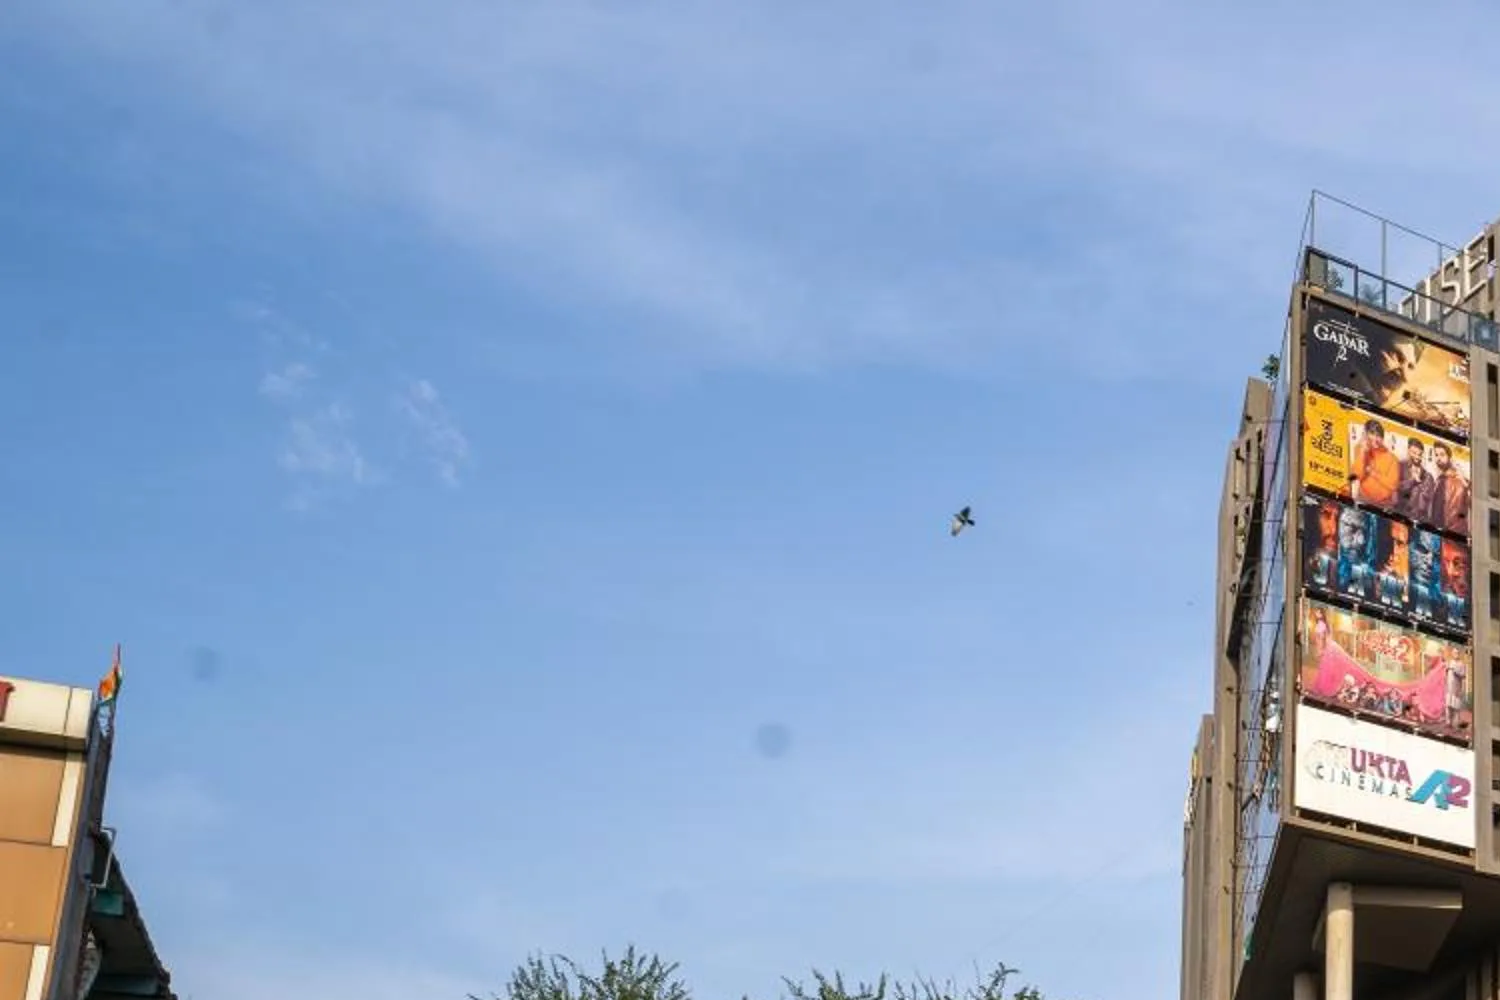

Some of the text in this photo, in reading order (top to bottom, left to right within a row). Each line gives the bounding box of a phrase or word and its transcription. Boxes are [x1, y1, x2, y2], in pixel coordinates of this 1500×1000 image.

[1313, 321, 1370, 358] GADAR
[1314, 764, 1413, 801] CINEMAS
[1349, 747, 1413, 786] UKTA
